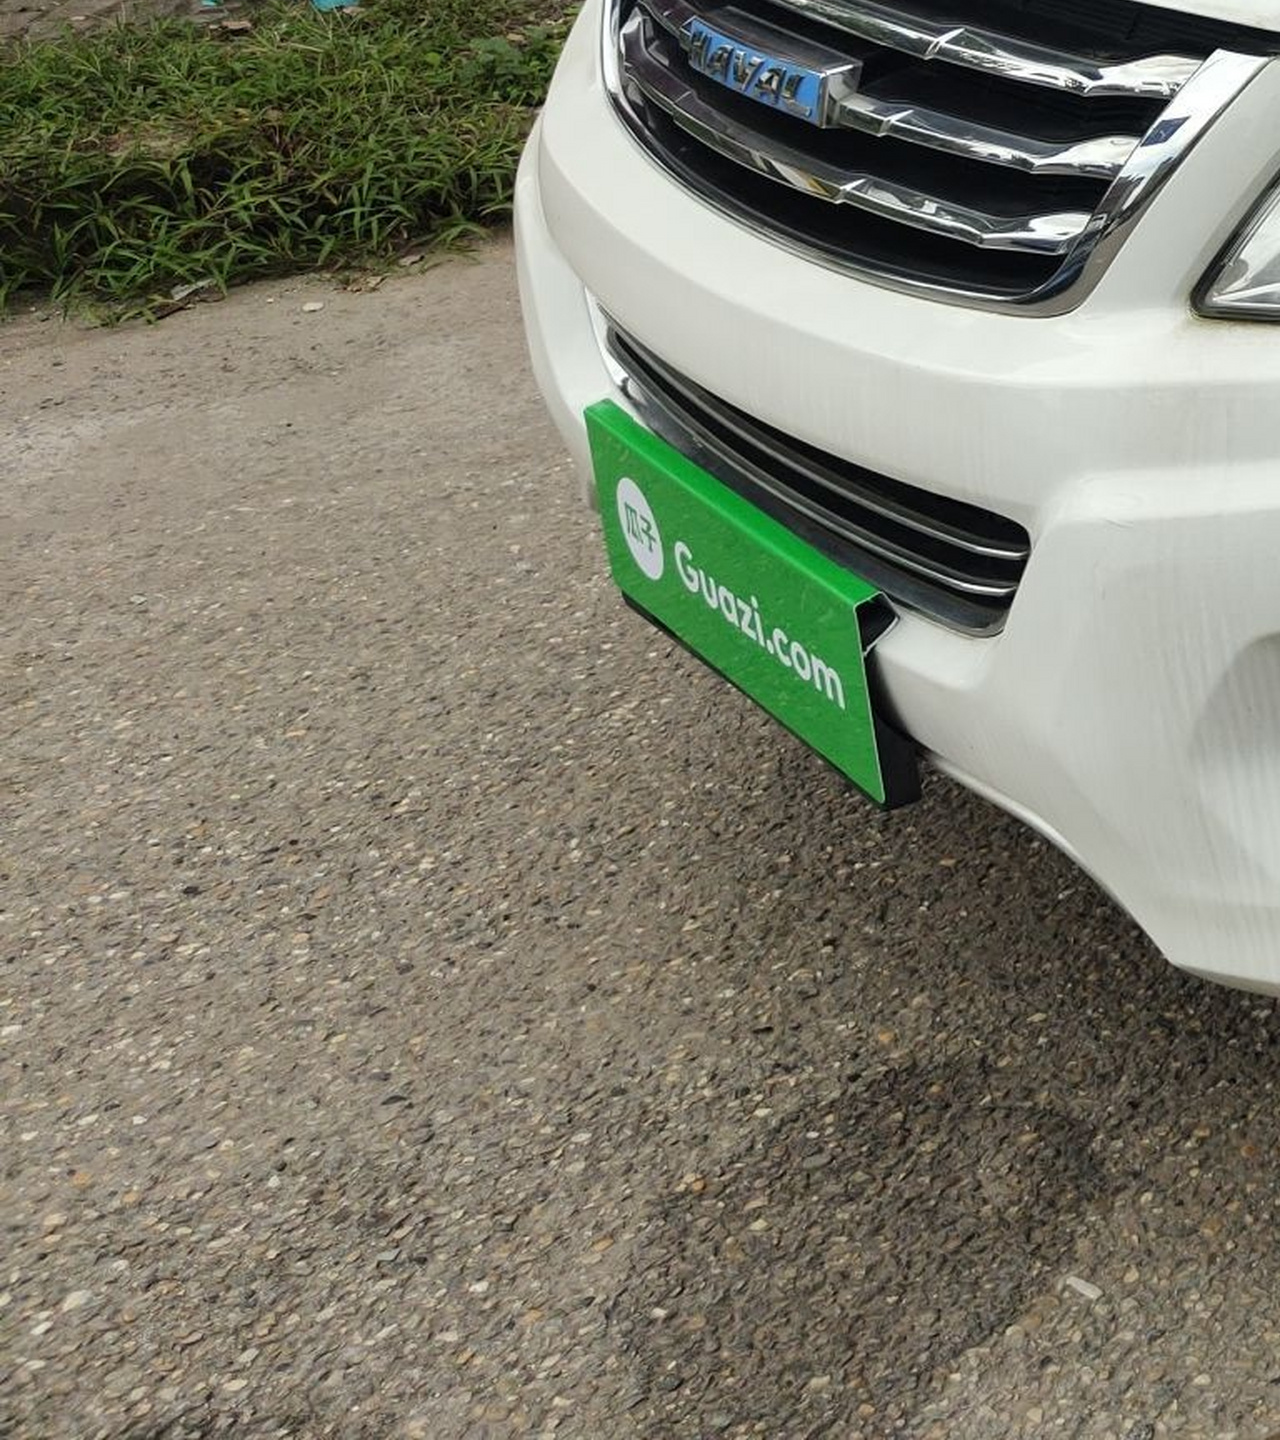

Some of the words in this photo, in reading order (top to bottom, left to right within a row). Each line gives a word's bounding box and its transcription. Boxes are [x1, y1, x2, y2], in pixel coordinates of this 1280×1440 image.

[690, 30, 813, 117] HAVAL
[624, 501, 657, 553] 瓜子
[674, 541, 846, 710] Guazi.com
